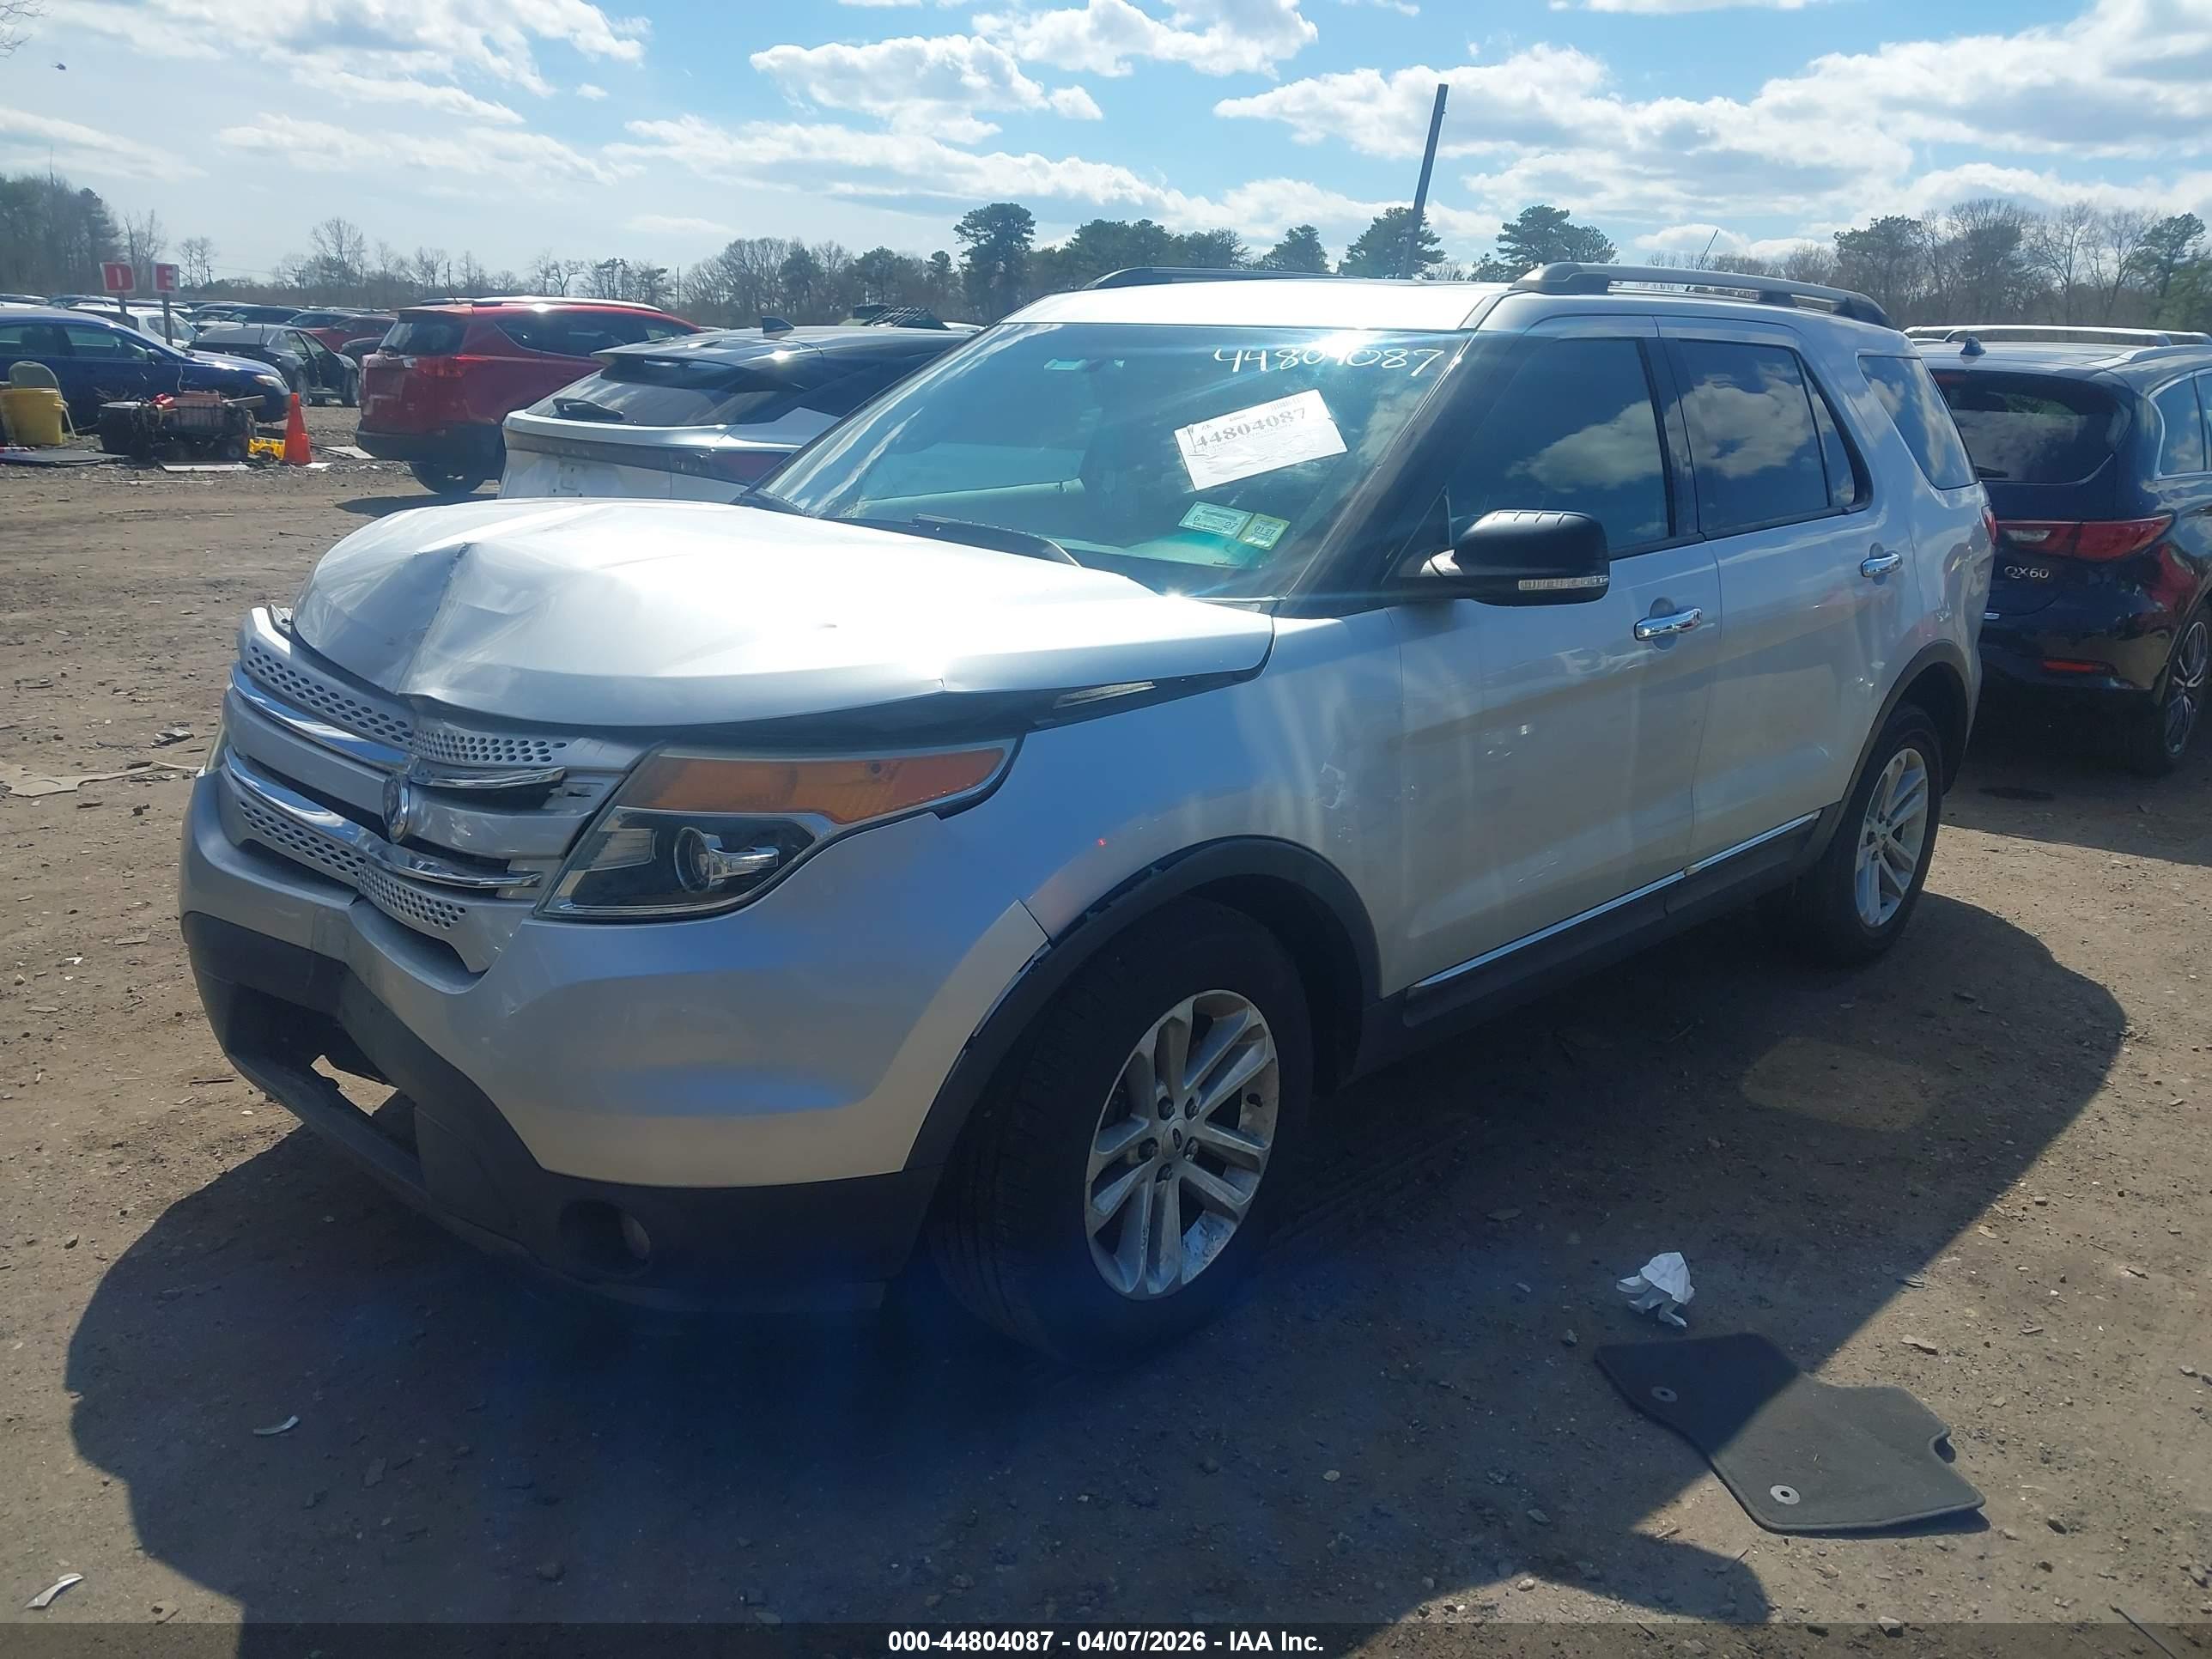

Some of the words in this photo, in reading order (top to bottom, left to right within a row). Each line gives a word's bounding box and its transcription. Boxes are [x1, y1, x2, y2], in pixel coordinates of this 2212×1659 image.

[105, 264, 134, 290] D
[156, 264, 175, 290] E
[1195, 407, 1307, 448] 44804087
[1223, 520, 1239, 530] 27
[2004, 565, 2050, 579] QX60
